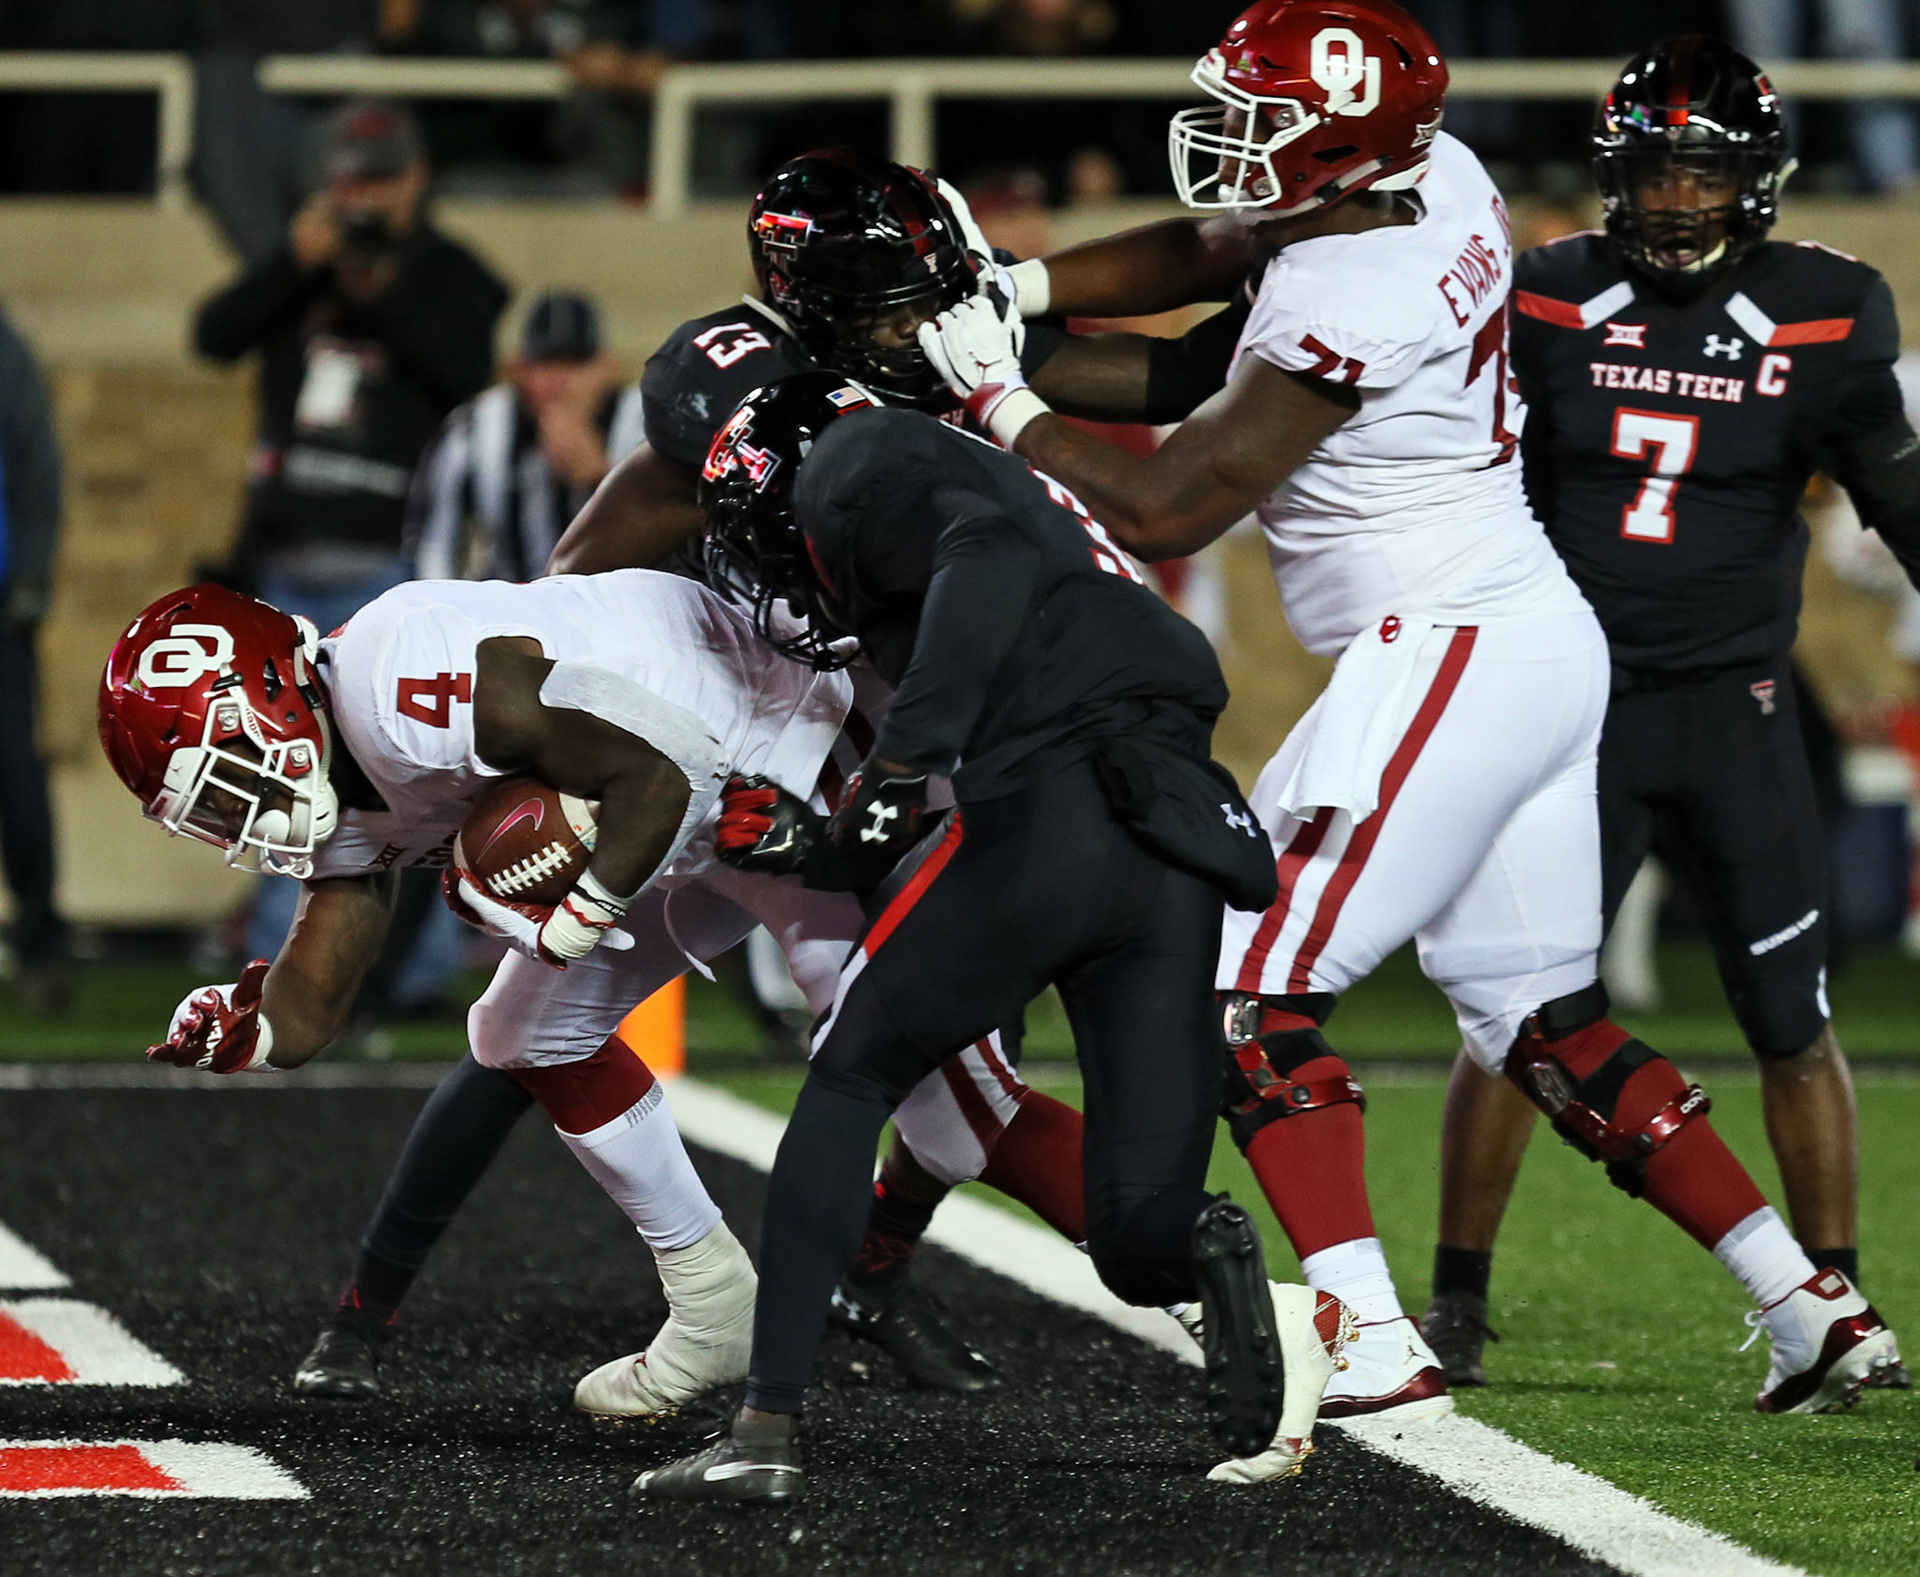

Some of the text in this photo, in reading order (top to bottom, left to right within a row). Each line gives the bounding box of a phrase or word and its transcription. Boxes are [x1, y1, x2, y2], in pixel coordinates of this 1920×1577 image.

[1437, 233, 1502, 329] EVANS
[1589, 362, 1746, 403] TEXAS TECH
[1755, 353, 1793, 397] C
[1609, 405, 1701, 546] 7
[396, 671, 472, 729] 4
